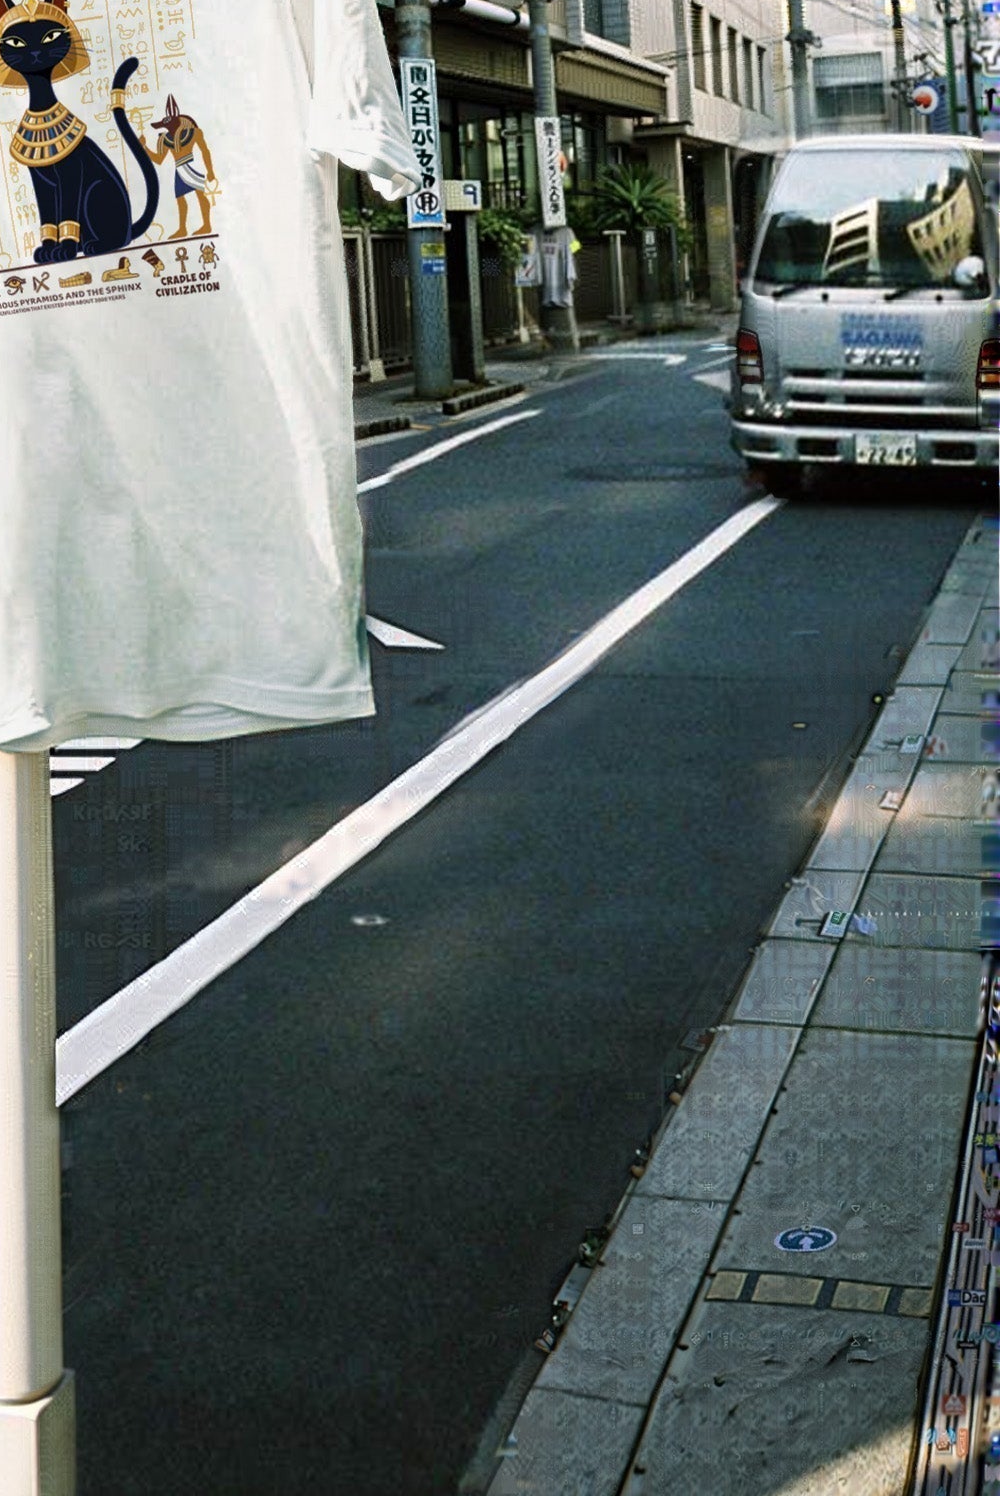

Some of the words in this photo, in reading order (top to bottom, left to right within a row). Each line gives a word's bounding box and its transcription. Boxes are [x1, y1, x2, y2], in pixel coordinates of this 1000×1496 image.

[161, 273, 197, 286] CRADLE
[198, 271, 211, 281] OF
[20, 294, 64, 306] PYRAMIDS
[65, 290, 85, 299] AND
[87, 288, 104, 297] THE
[105, 282, 142, 294] SPHINX
[155, 282, 220, 297] CIVILIZATION
